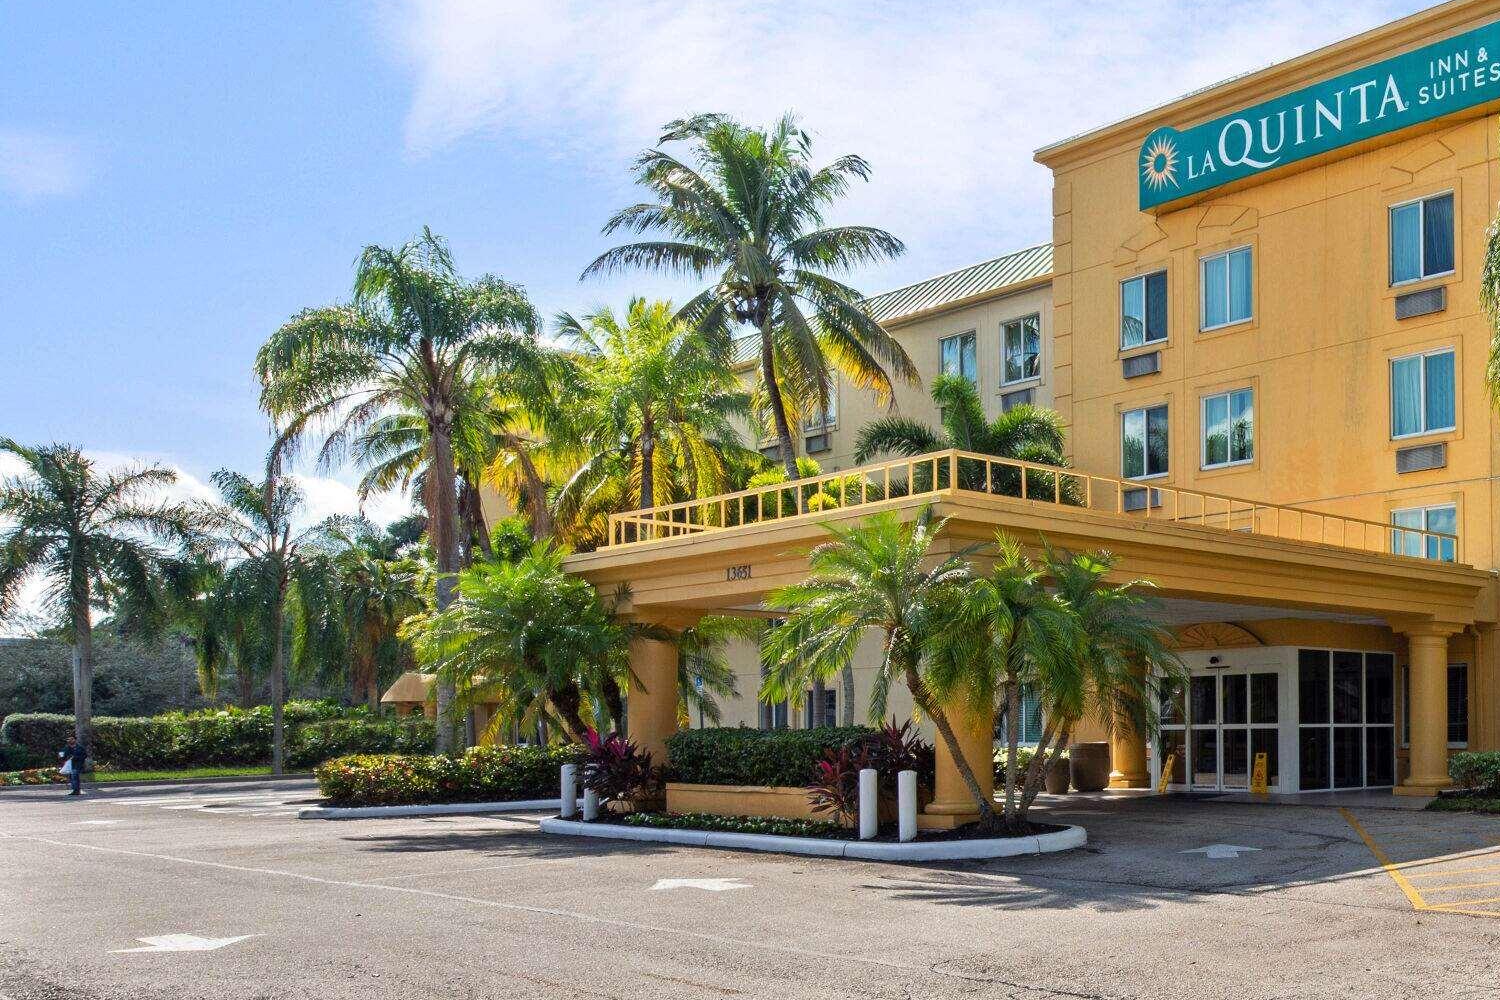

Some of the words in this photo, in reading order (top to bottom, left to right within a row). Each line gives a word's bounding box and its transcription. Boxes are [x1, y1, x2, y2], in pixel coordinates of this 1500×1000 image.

[1429, 50, 1468, 79] INN
[1477, 47, 1489, 62] &
[1187, 150, 1216, 180] LA
[1218, 73, 1407, 169] QUINTA
